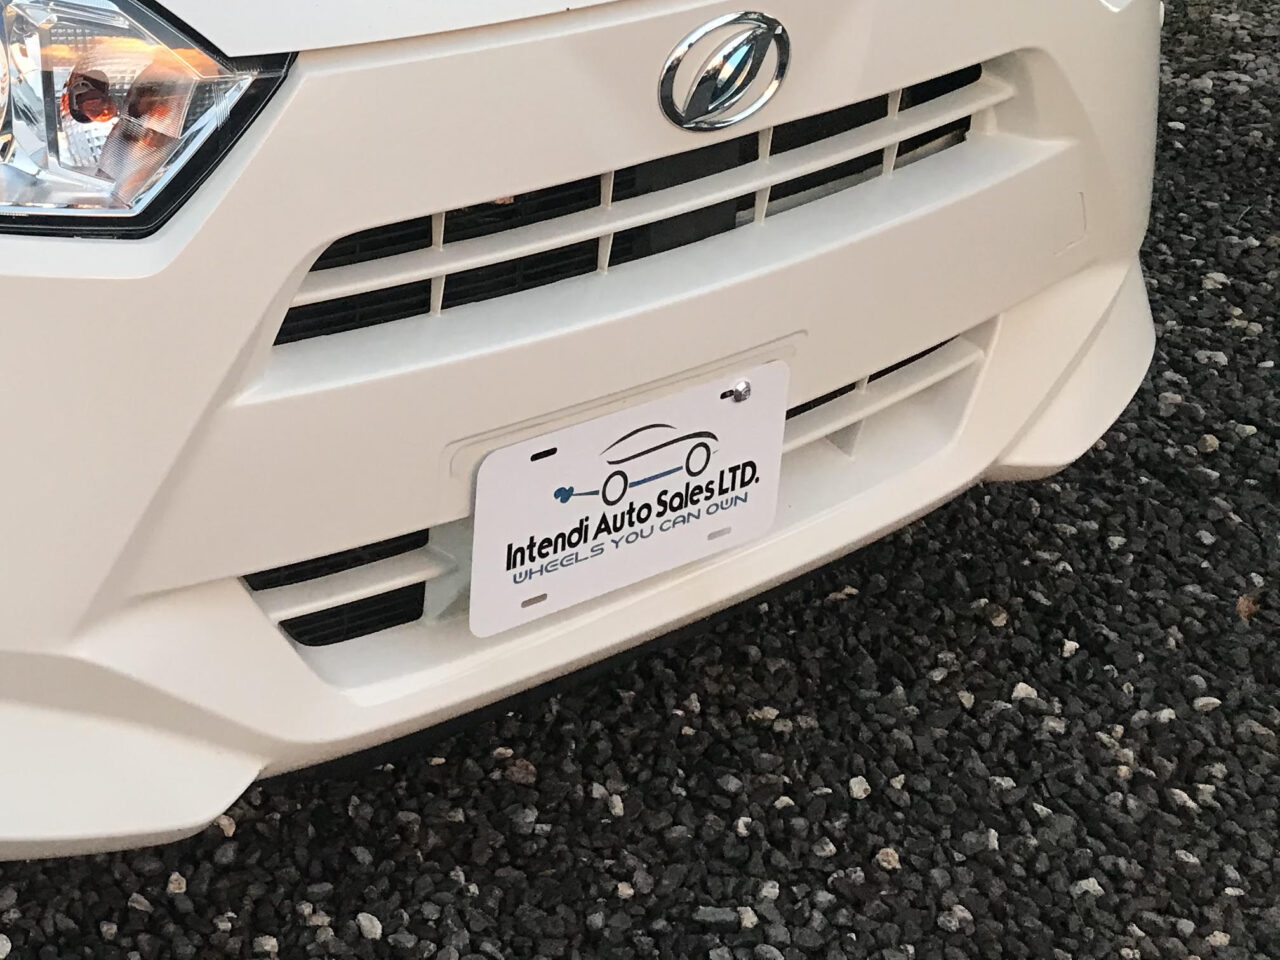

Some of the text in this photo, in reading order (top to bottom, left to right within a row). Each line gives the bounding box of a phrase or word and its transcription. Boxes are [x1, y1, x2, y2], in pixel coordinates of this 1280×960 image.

[505, 460, 761, 572] Intendi Auto Sales LTD.
[512, 491, 748, 585] WHEELS YOU CAN OWN
